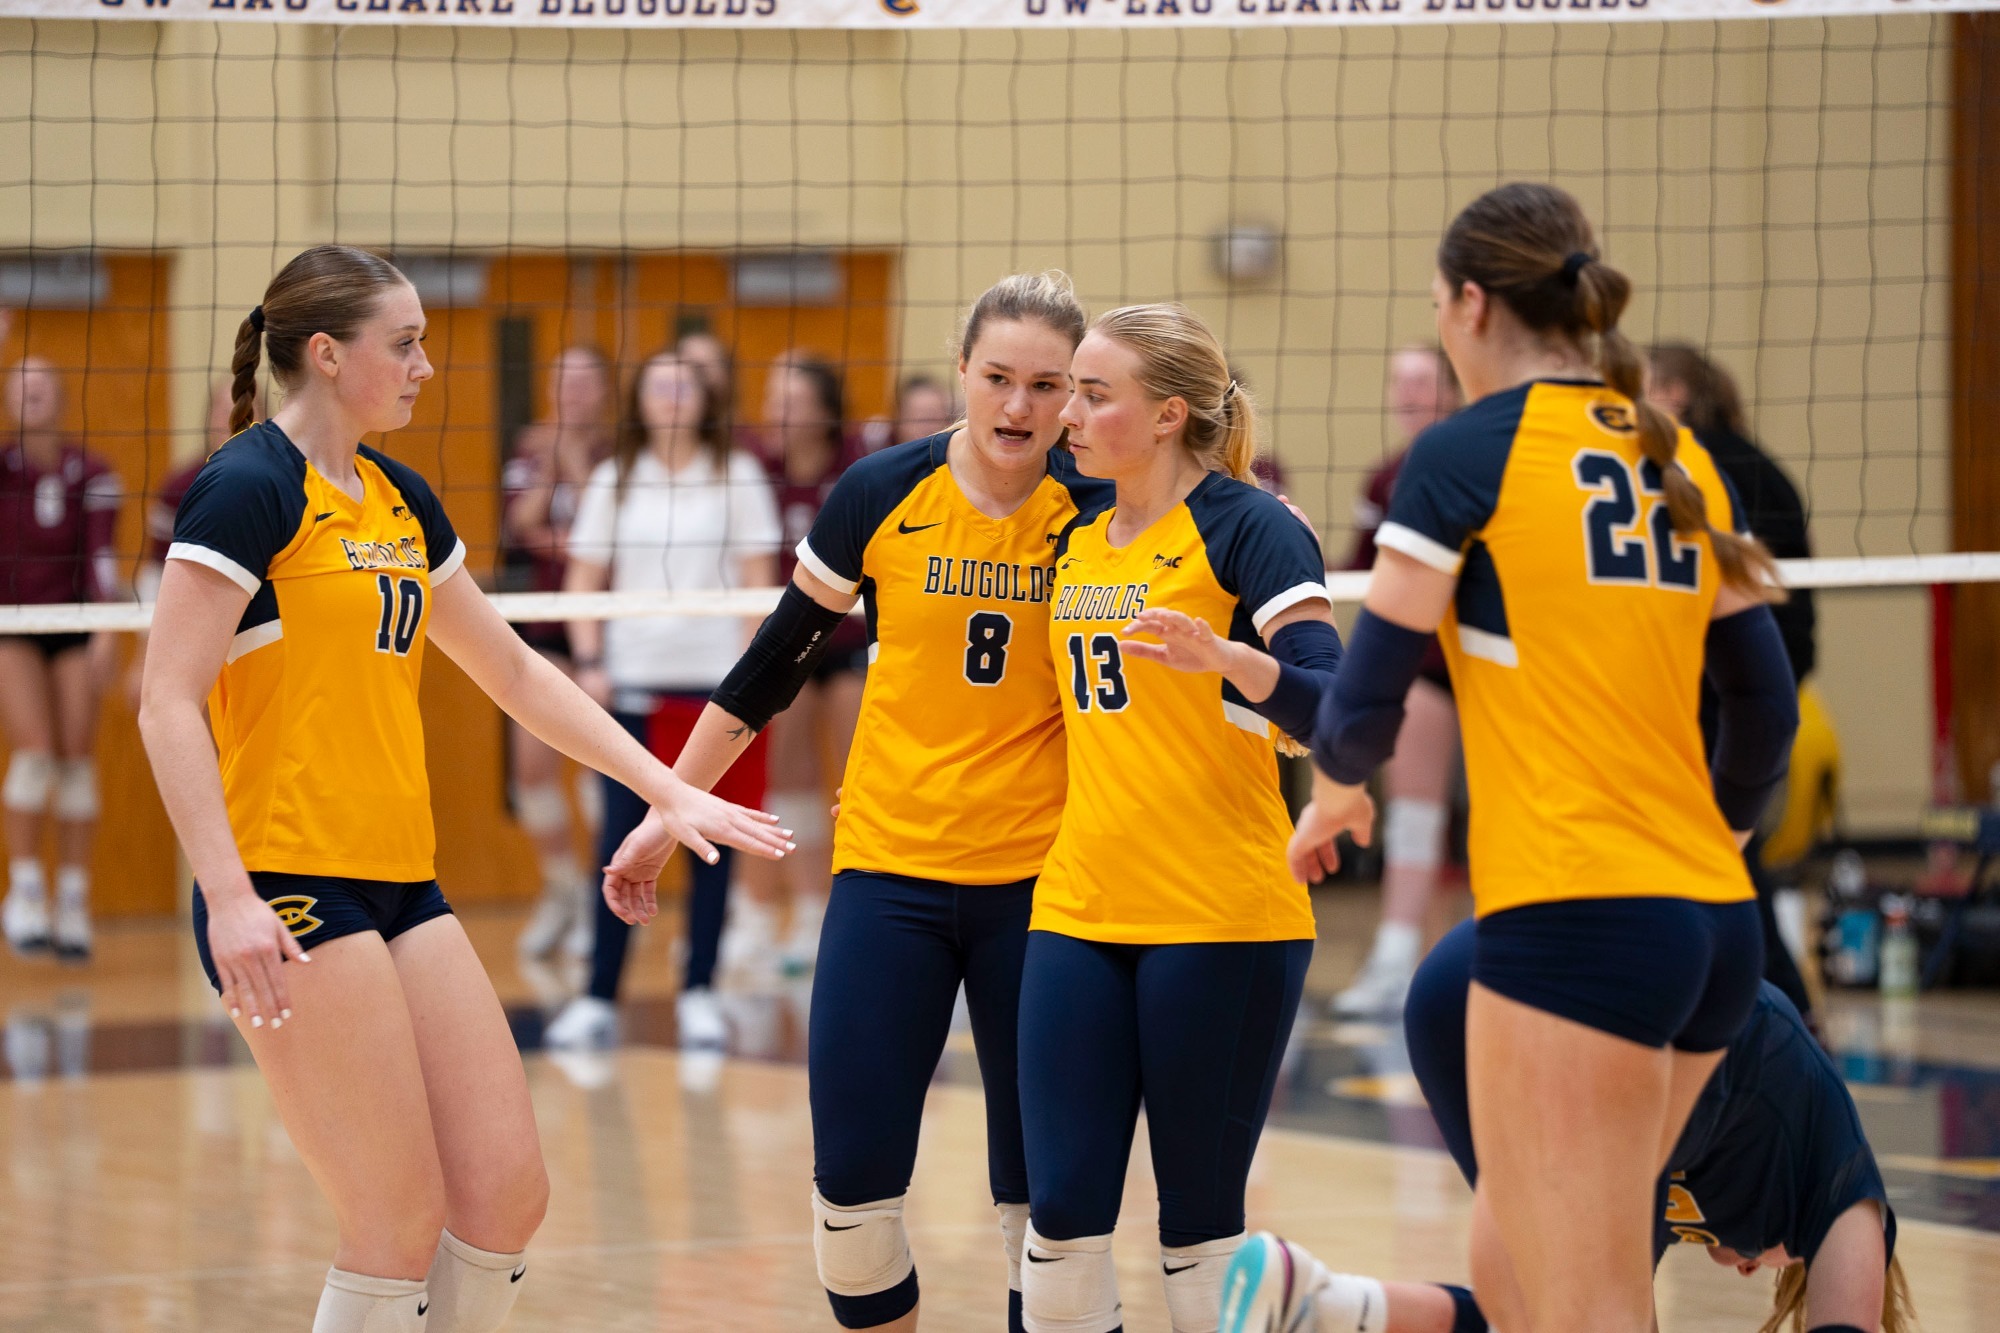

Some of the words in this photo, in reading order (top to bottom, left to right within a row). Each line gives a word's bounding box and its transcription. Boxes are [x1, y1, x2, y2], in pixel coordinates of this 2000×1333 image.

[1570, 447, 1701, 595] 22
[375, 572, 424, 658] 10
[924, 555, 1055, 604] BLUGOLDS
[1053, 583, 1149, 621] BLUGOLDS
[963, 609, 1014, 687] 8
[1066, 632, 1131, 714] 13
